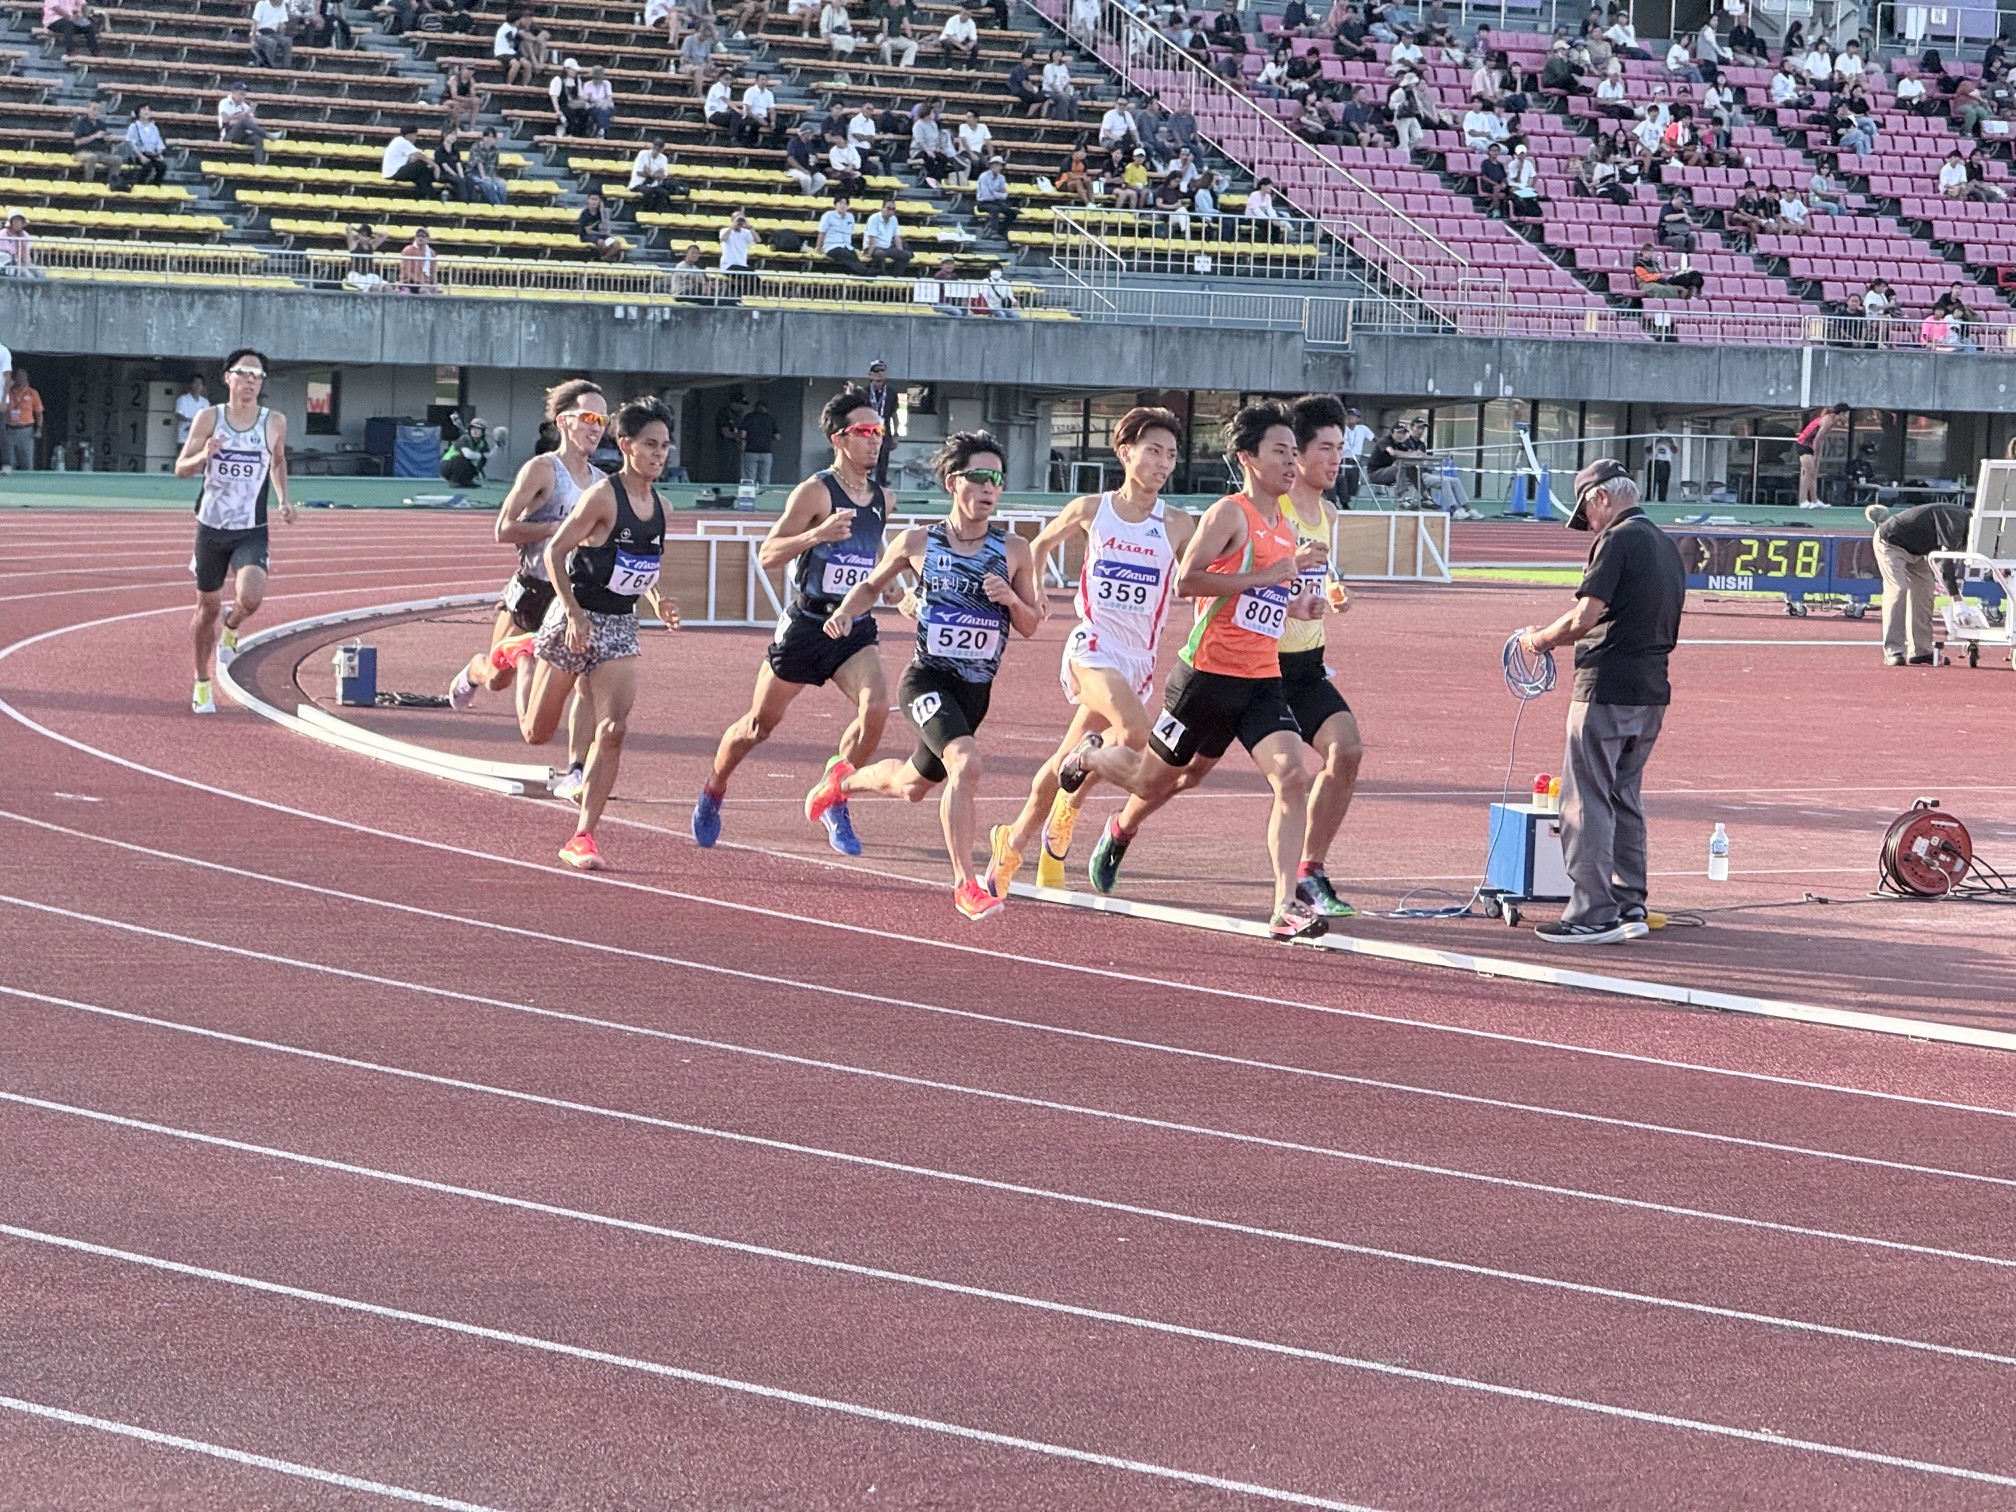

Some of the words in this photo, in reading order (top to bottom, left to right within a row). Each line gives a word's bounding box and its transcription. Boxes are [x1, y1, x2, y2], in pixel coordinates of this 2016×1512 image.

[131, 383, 142, 406] 2
[218, 462, 254, 478] 669
[1102, 537, 1157, 556] Aisan
[1734, 538, 1820, 579] 2.58
[620, 570, 655, 589] 764
[931, 575, 979, 595] 日本リファ
[1708, 575, 1754, 591] NISHI
[1098, 581, 1147, 605] 359
[1245, 601, 1284, 629] 809
[938, 628, 989, 650] 520
[916, 695, 937, 721] 10
[1160, 720, 1178, 741] 4
